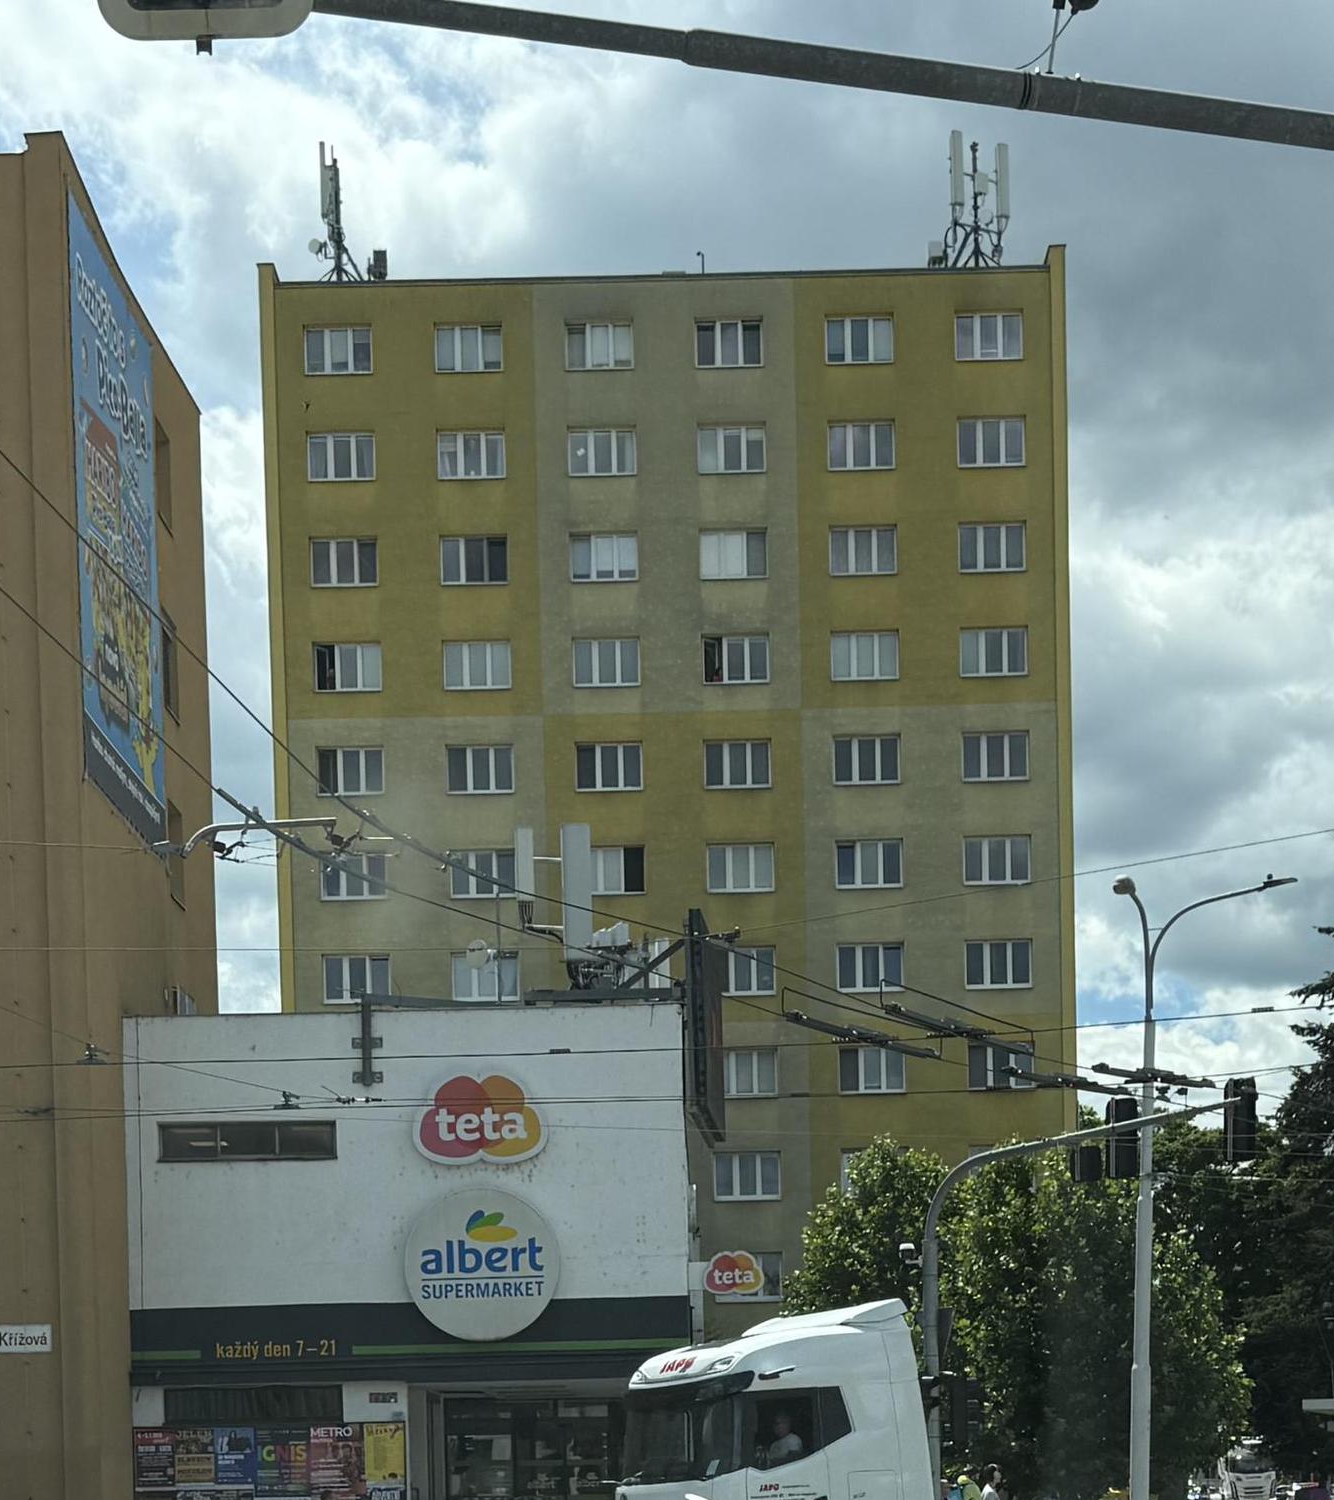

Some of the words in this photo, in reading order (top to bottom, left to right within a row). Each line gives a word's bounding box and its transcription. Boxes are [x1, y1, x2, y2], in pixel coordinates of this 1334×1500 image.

[435, 1106, 528, 1141] teta
[420, 1237, 545, 1275] albert
[713, 1268, 755, 1285] teta
[421, 1281, 544, 1300] SUPERMARKET
[216, 1341, 259, 1360] každý
[264, 1341, 291, 1357] den
[310, 1426, 353, 1438] METRO
[257, 1444, 308, 1462] IGNIS
